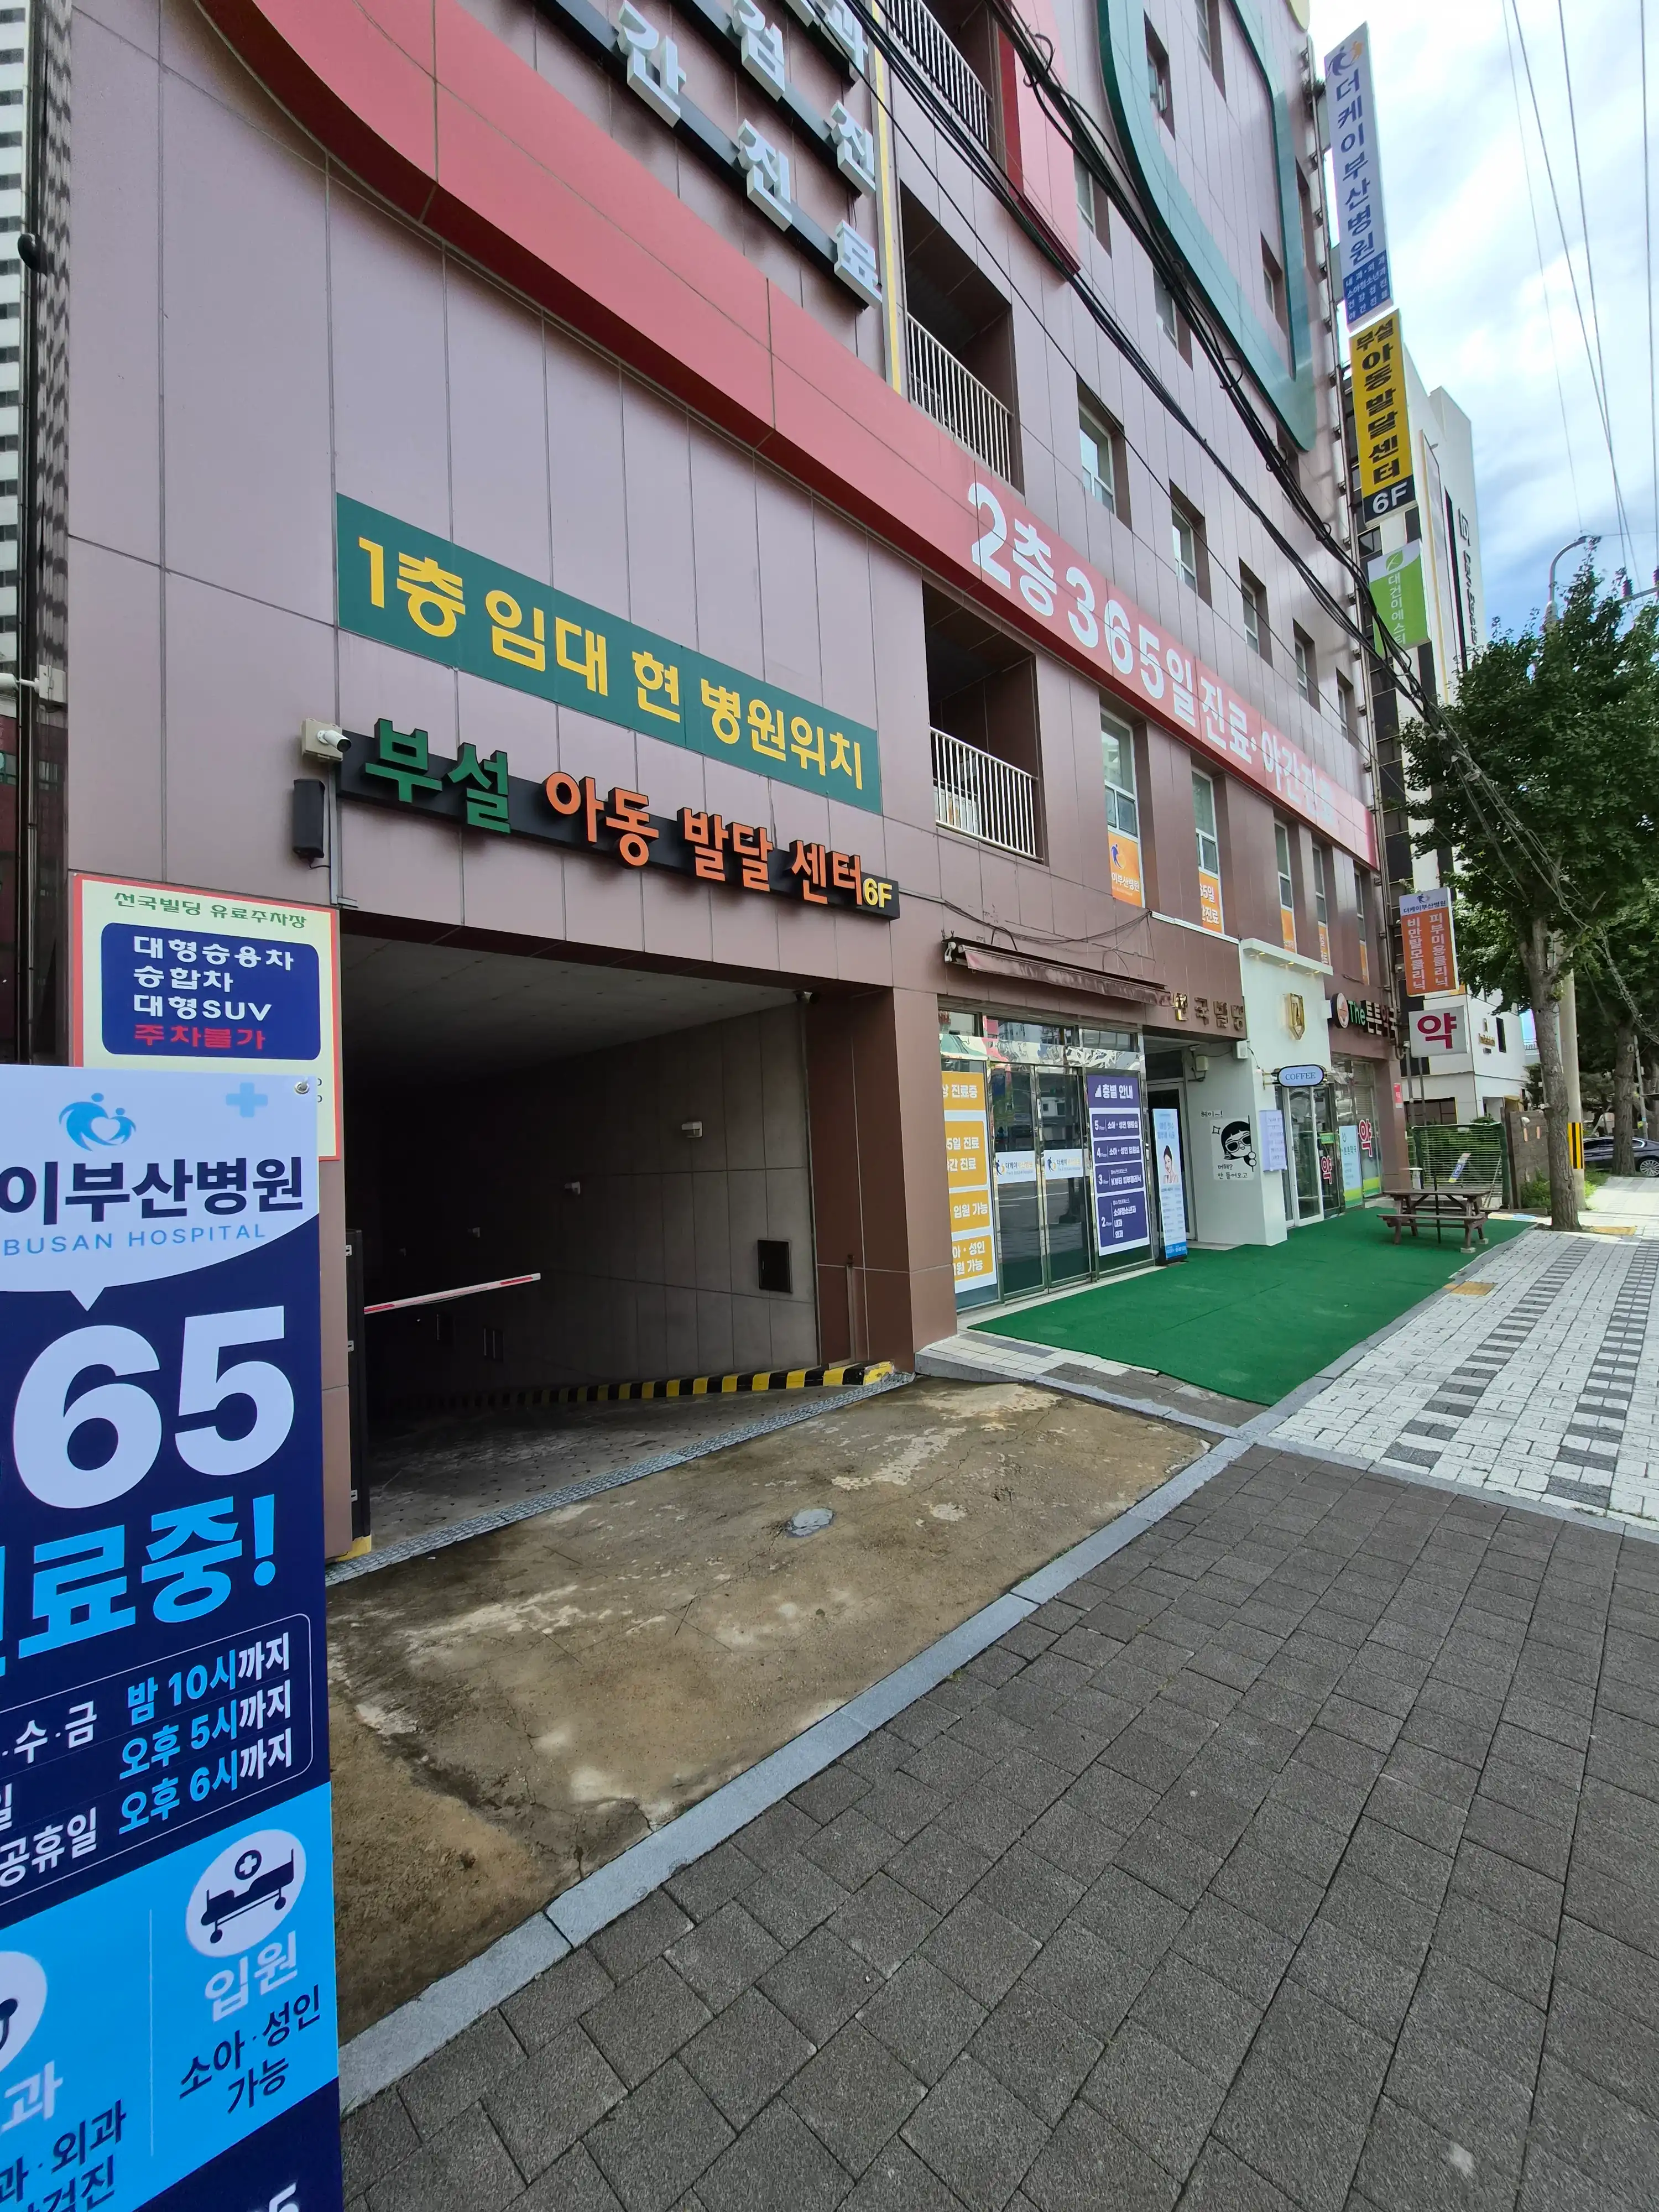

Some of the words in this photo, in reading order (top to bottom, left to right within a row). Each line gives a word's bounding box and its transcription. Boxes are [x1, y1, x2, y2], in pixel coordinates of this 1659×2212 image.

[1335, 67, 1375, 267] 더케이부산병원
[1355, 317, 1394, 352] 부설
[1371, 479, 1407, 515] 6F
[359, 537, 466, 637] 1층
[485, 589, 608, 697] 임대
[632, 650, 680, 723] 현
[700, 679, 863, 791] 병원위치
[364, 717, 512, 834] 부설
[545, 771, 659, 867] 아동
[677, 807, 774, 892] 발달
[114, 891, 201, 916] 선국빌딩
[210, 904, 307, 930] 유료주차장
[1403, 900, 1446, 913] 더케이부산병원
[133, 935, 294, 972] 대형승용차
[1407, 916, 1426, 990] 비만탈모클리닉
[1428, 912, 1449, 987] 피부미용클리닉
[133, 965, 234, 993] 승합차
[133, 994, 273, 1022] 대형SUV
[134, 1024, 267, 1050] 주차불가
[1417, 1012, 1457, 1050] 약
[951, 1084, 978, 1099] 진료중
[1118, 1084, 1133, 1099] 안내
[1285, 1072, 1316, 1081] COFFEE
[1094, 1120, 1099, 1130] 5
[1359, 1119, 1373, 1157] 약
[963, 1136, 979, 1150] 진료
[1096, 1147, 1101, 1158] 4
[960, 1157, 976, 1171] 진료
[1098, 1174, 1103, 1185] 3
[1321, 1155, 1332, 1185] 약
[0, 1156, 303, 1225] 이부산병원
[953, 1203, 970, 1218] 입원
[972, 1202, 988, 1215] 가능
[1101, 1217, 1106, 1227] 2
[4, 1233, 112, 1256] BUSAN
[129, 1223, 266, 1248] HOSPITAL
[967, 1259, 983, 1272] 가능
[13, 1305, 294, 1509] 65
[0, 1493, 276, 1659] 료중!
[127, 1676, 158, 1726] 밤
[168, 1631, 290, 1706] 10시까지
[119, 1724, 181, 1781] 오후
[190, 1679, 291, 1751] 5시까지
[0, 1807, 97, 1887] 공휴일
[118, 1776, 181, 1835] 오후
[190, 1728, 293, 1802] 6시까지
[205, 1931, 299, 2023] 입원
[227, 2056, 290, 2115] 가능
